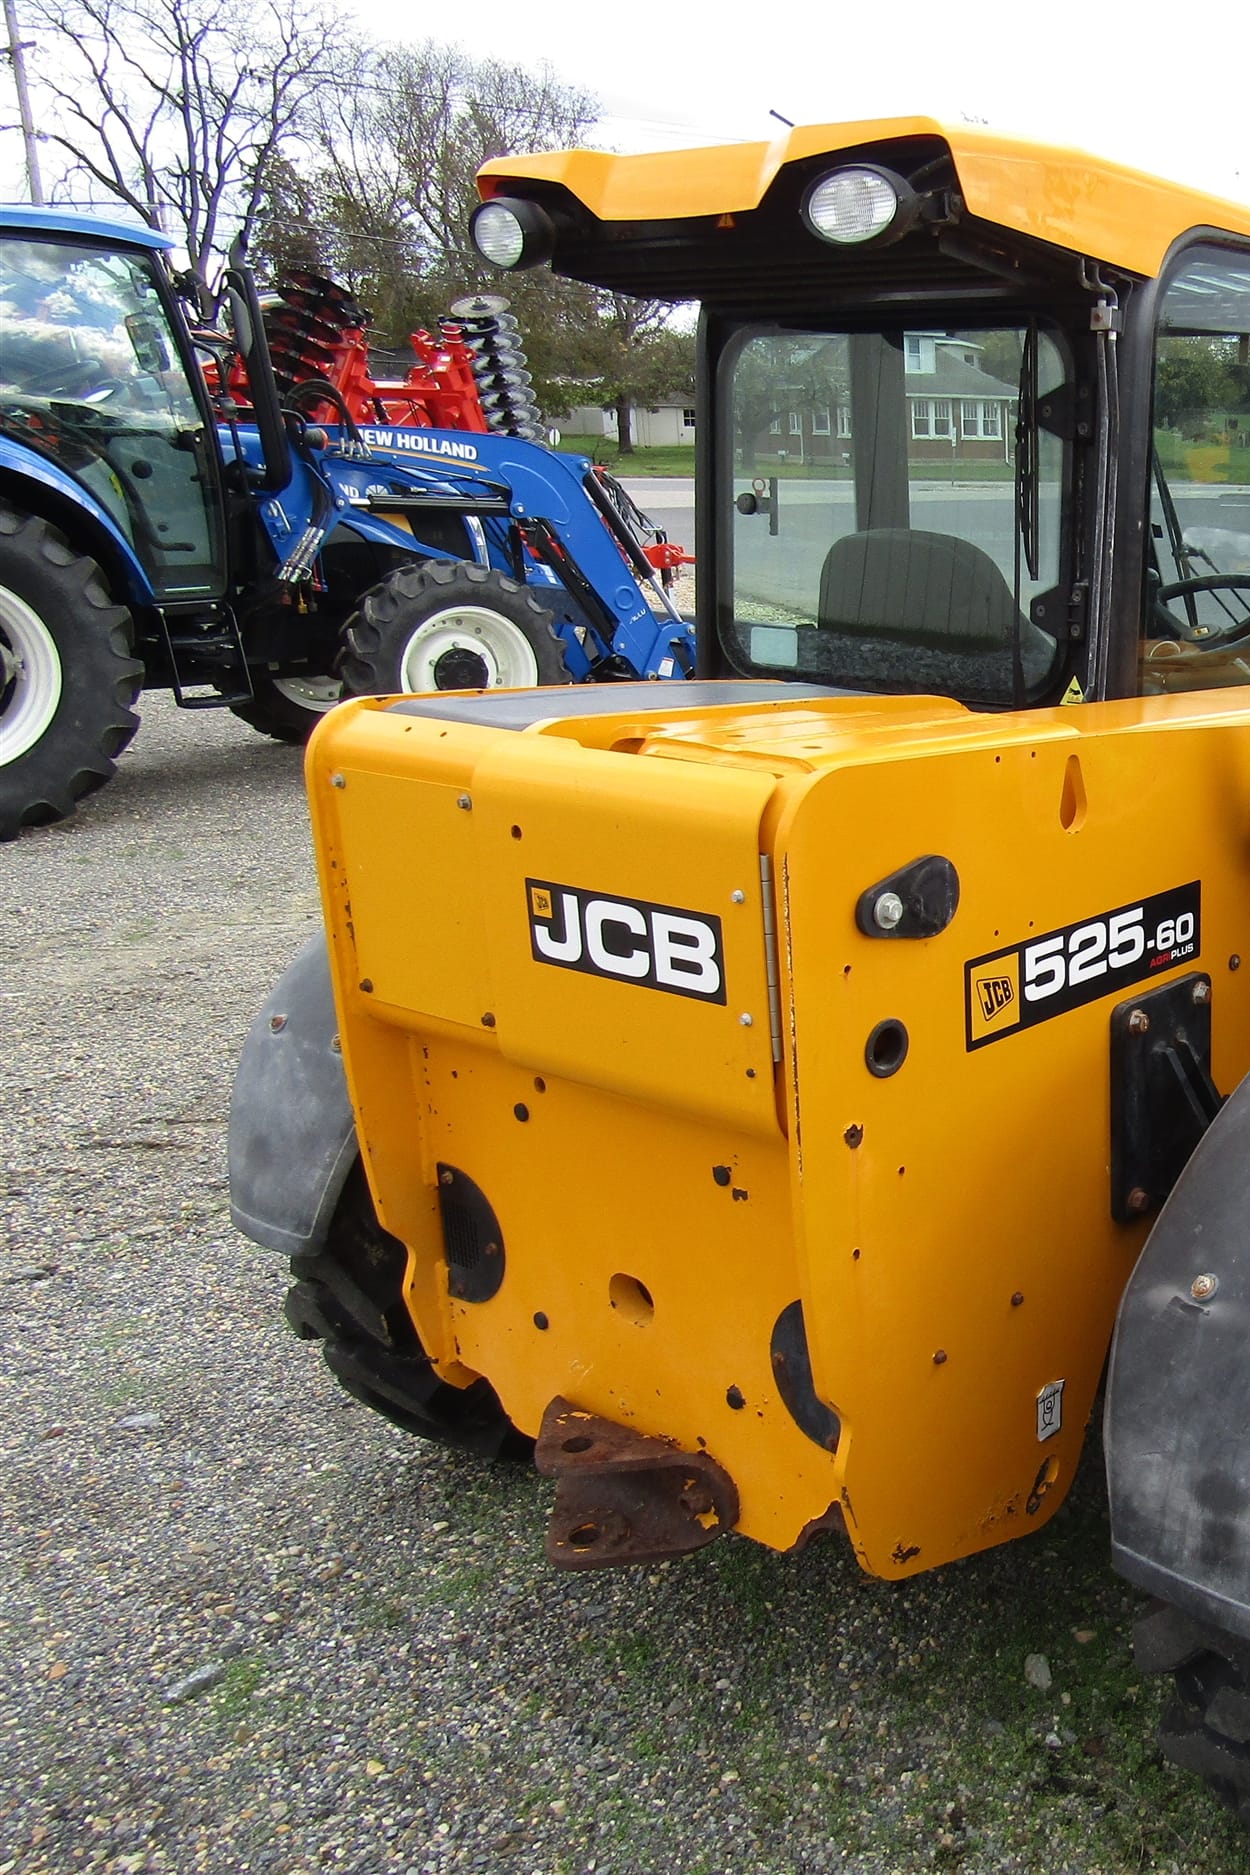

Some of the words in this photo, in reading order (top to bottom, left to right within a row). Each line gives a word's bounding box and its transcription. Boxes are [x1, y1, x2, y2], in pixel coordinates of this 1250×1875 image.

[397, 433, 478, 460] HOLLAND
[534, 893, 721, 994] JCB
[1024, 906, 1195, 1002] 525-60
[983, 979, 1012, 1015] JCB
